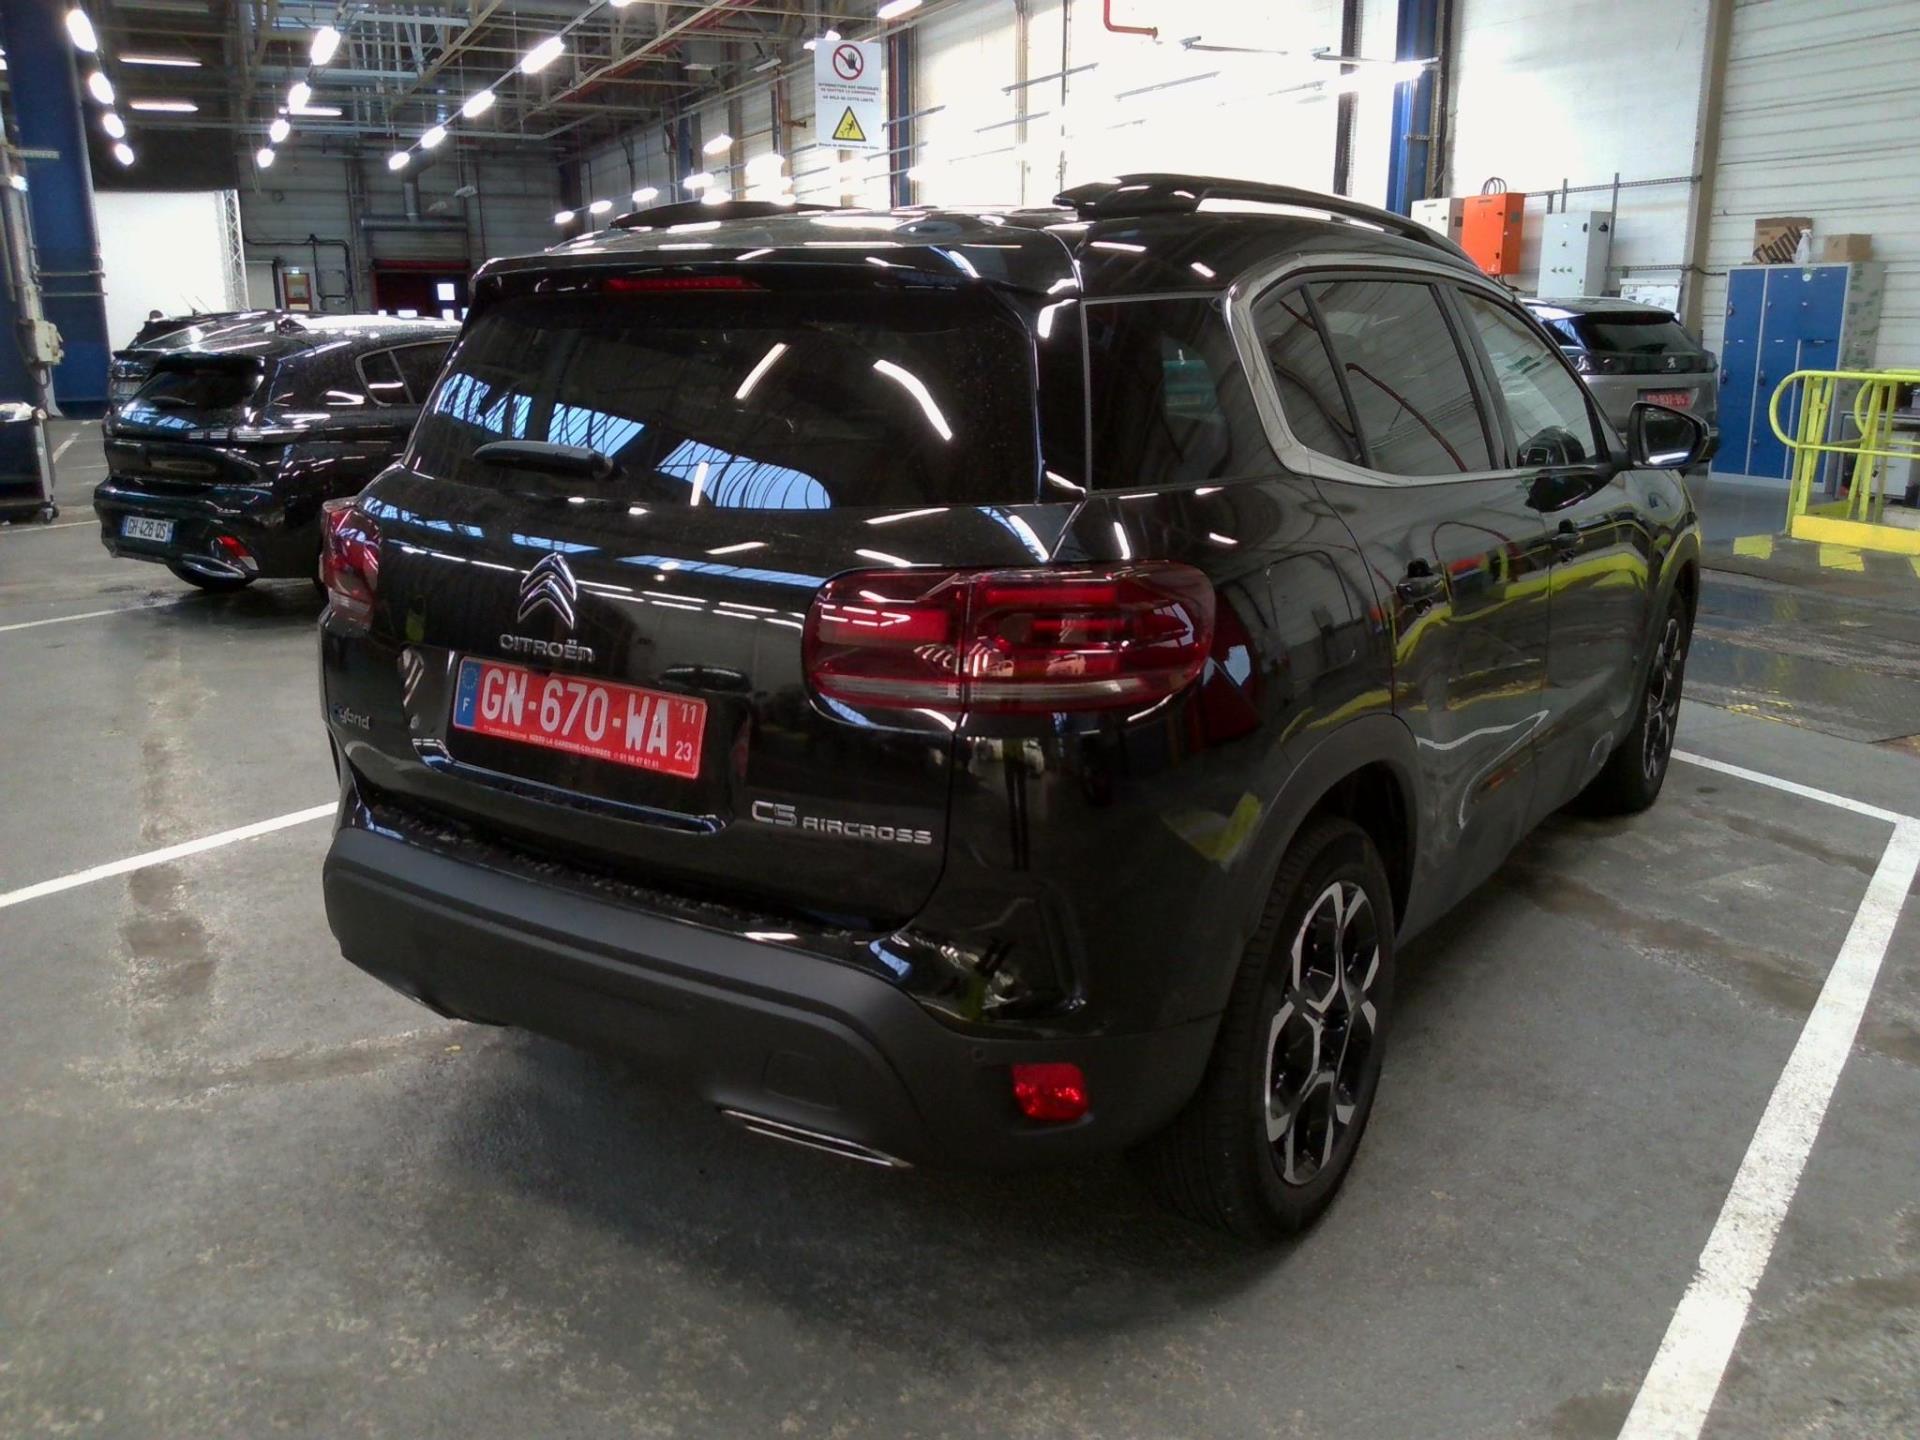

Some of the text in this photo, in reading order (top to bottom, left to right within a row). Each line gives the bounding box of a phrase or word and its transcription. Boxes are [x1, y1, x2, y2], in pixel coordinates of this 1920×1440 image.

[499, 634, 594, 662] CITROËN
[462, 697, 471, 712] F
[680, 703, 698, 725] 11
[674, 740, 693, 762] 23
[752, 800, 932, 845] C5 AIRCROSS
